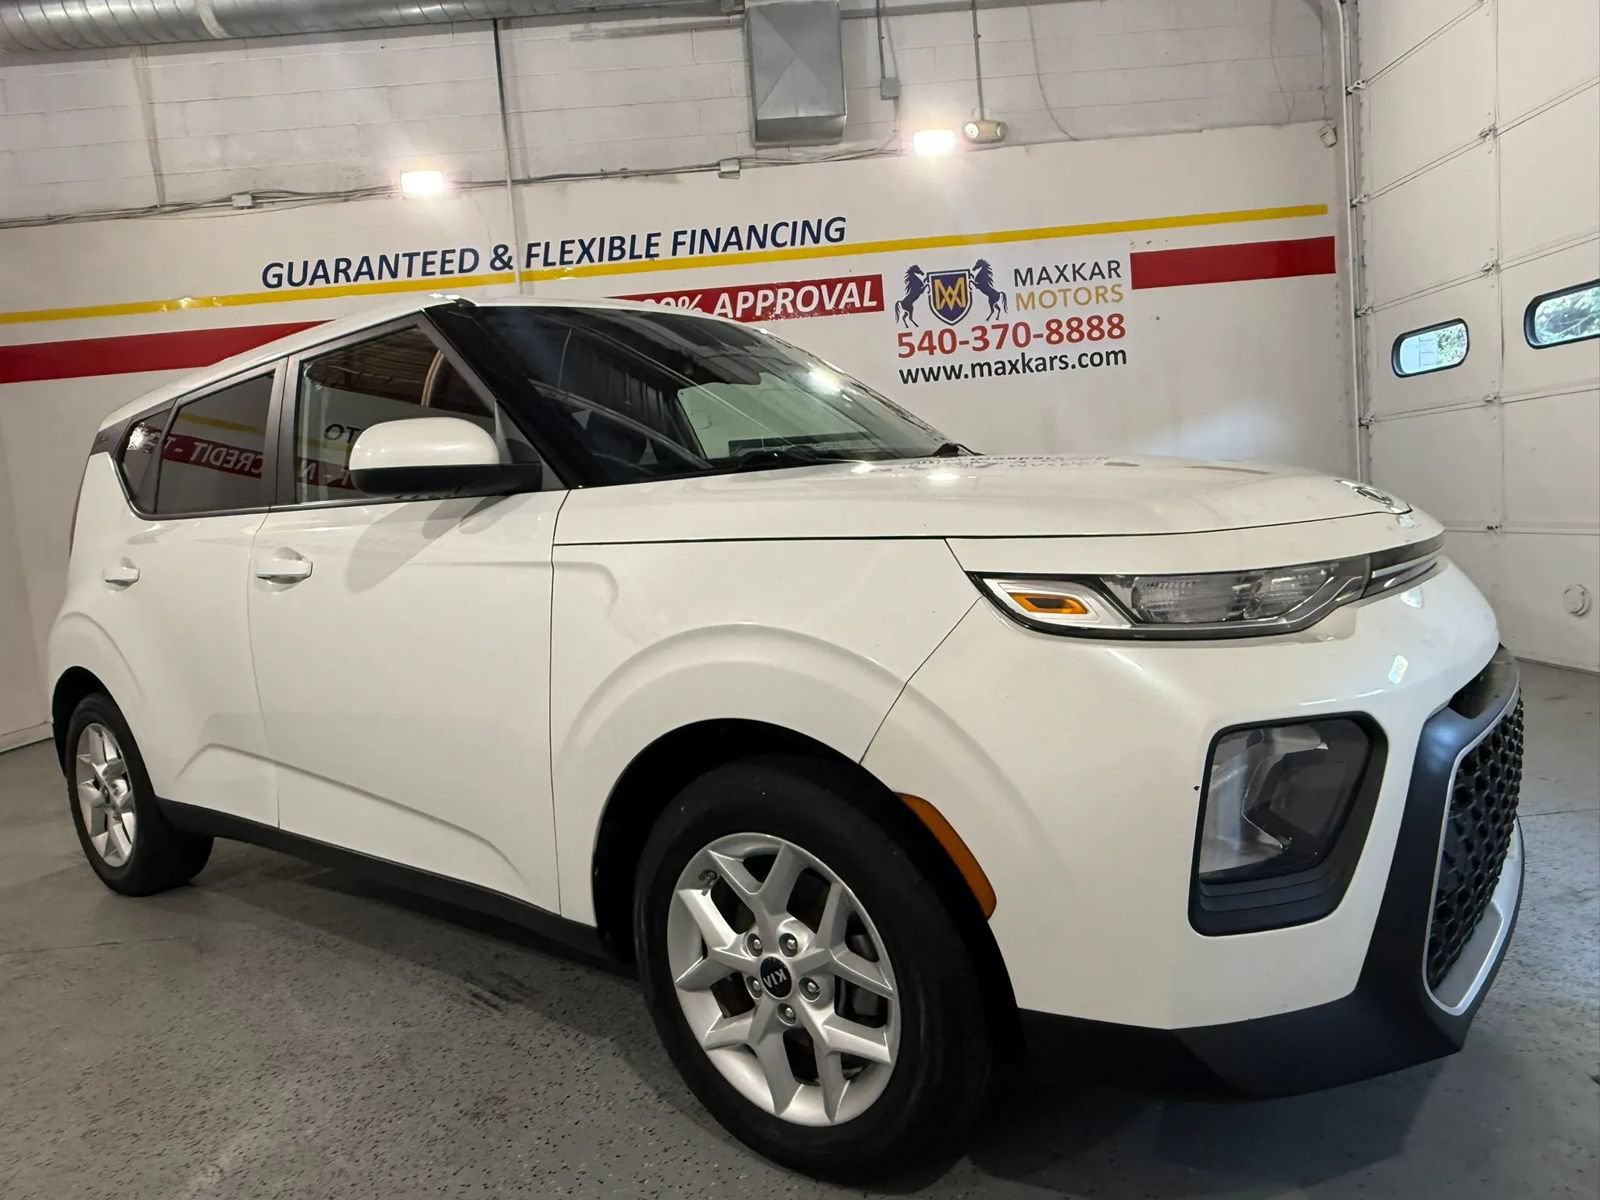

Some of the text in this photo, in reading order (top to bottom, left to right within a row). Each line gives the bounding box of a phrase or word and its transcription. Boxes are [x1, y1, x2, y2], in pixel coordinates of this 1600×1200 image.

[262, 216, 847, 289] GUARANTEED & FLEXIBLE FINANCING
[1013, 259, 1122, 288] MAXKAR
[712, 280, 878, 319] APPROVAL
[1015, 283, 1125, 312] MOTORS
[898, 312, 1127, 359] 540-370-8888
[899, 348, 1128, 385] www.maxkars.com
[762, 968, 788, 988] KIA
